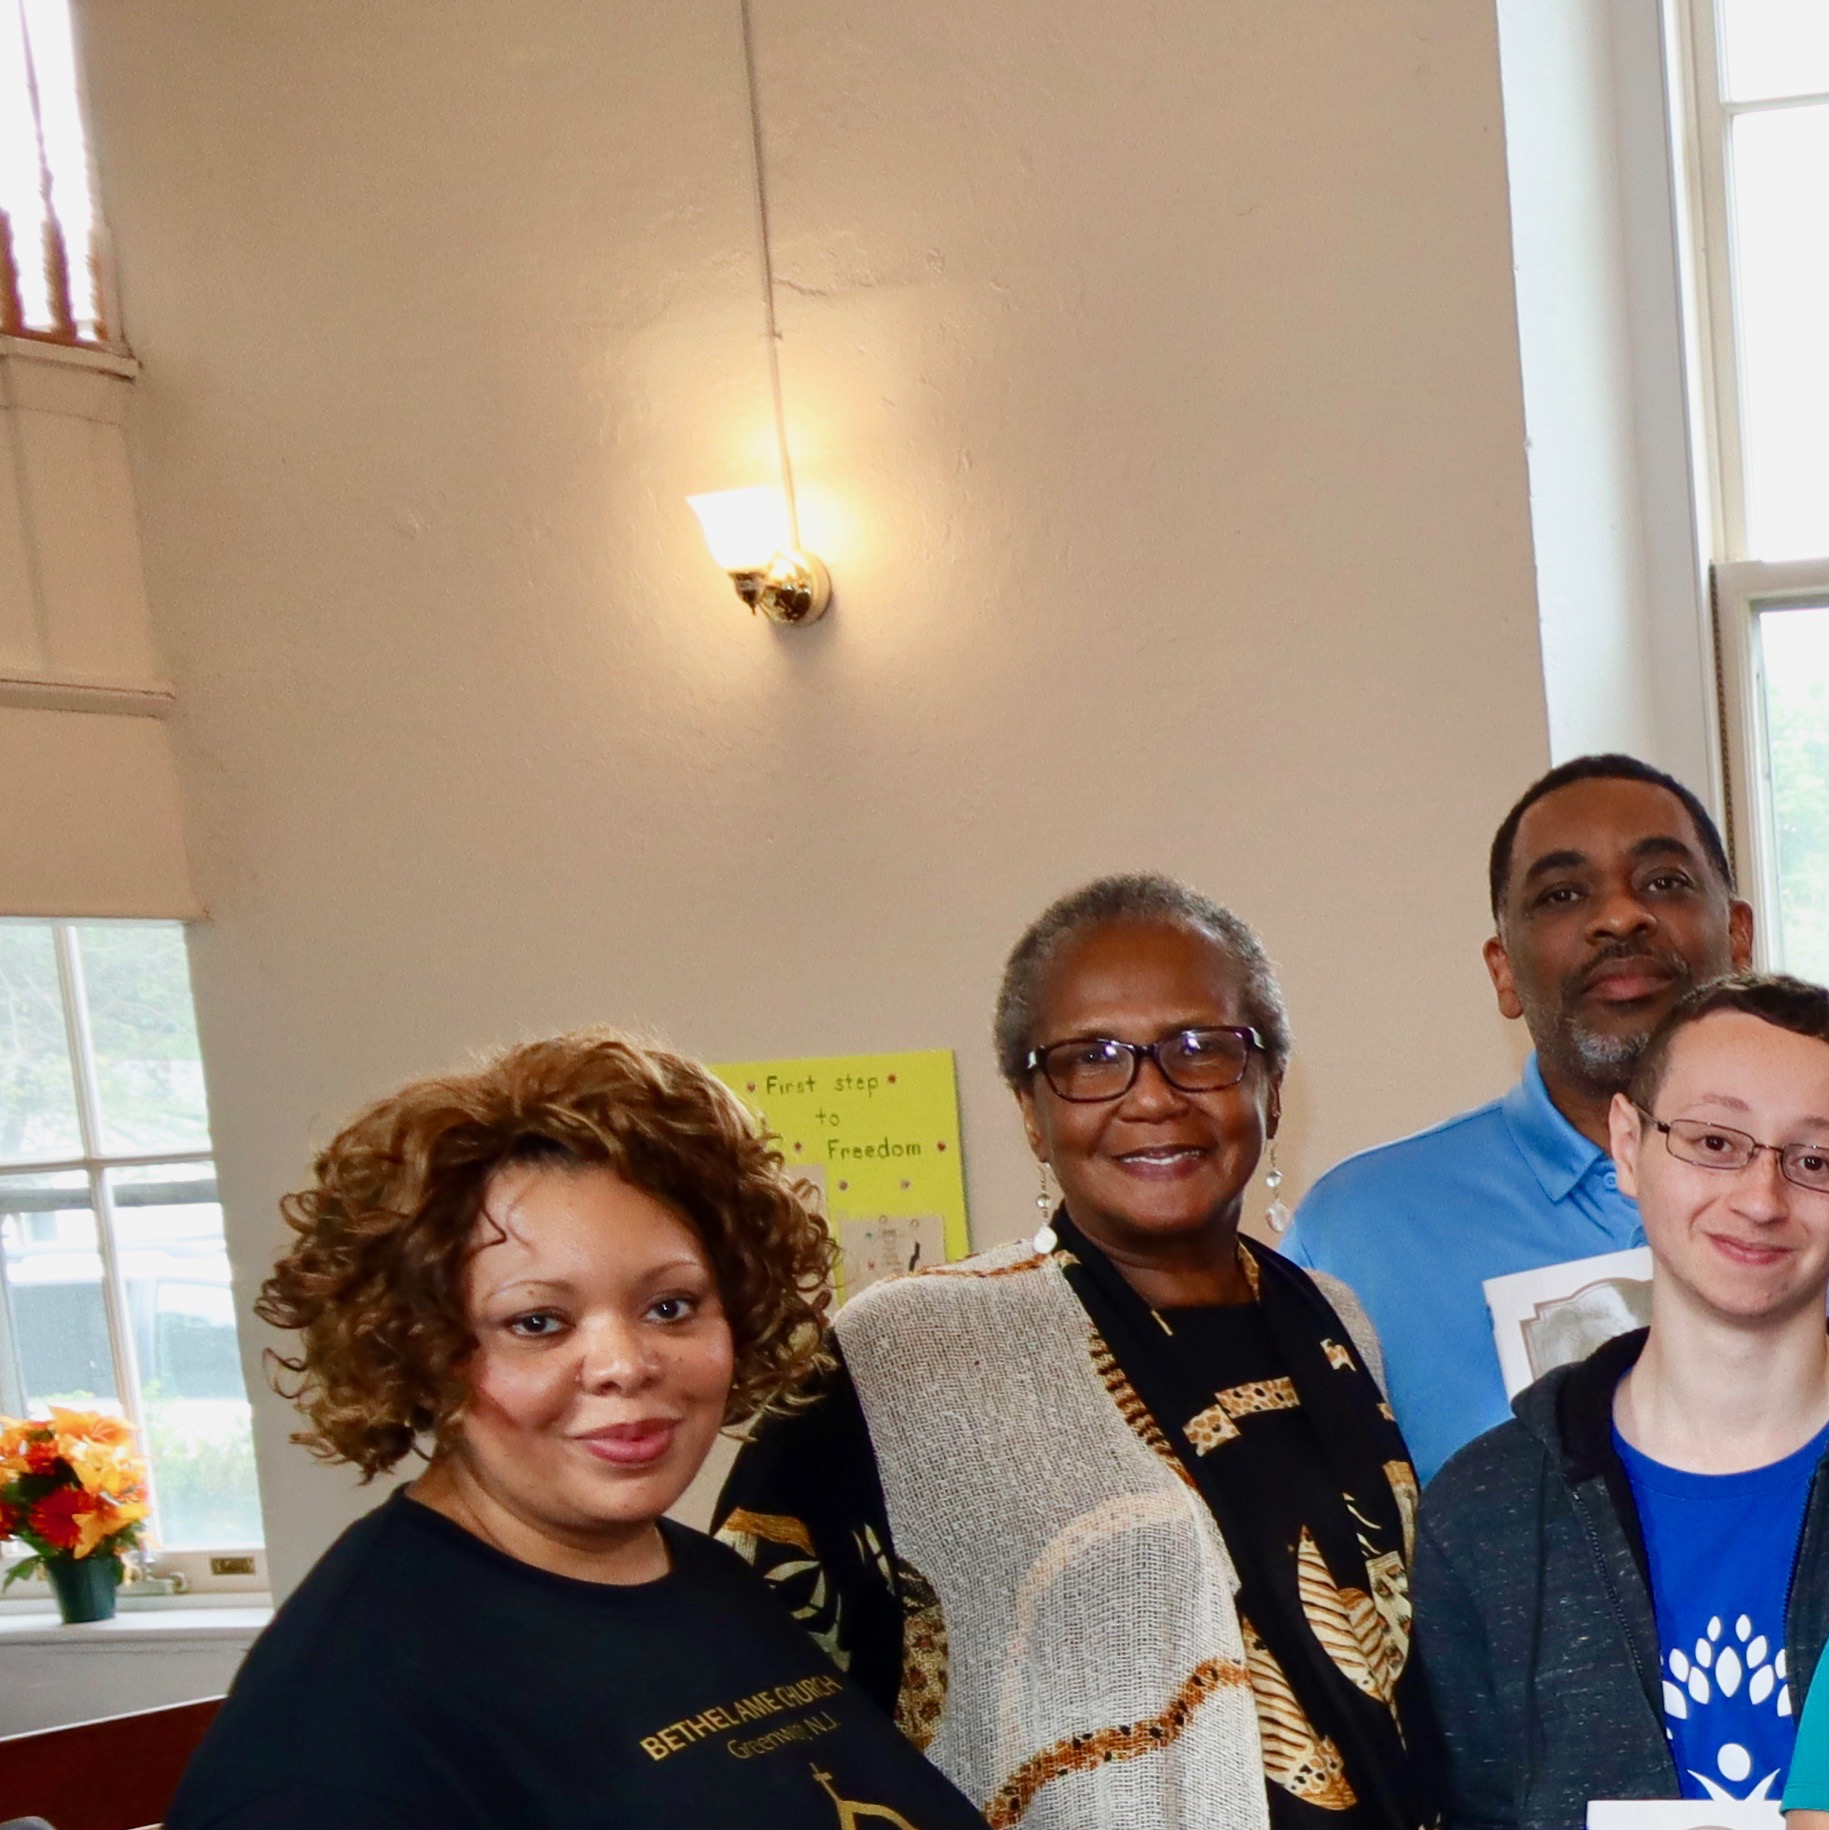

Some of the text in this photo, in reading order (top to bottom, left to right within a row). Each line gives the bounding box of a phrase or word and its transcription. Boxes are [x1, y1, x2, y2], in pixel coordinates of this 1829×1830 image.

[766, 1075, 879, 1098] First step
[815, 1108, 840, 1126] to
[827, 1138, 922, 1160] Freedom
[639, 1675, 844, 1761] BETHEL AME CHURCH
